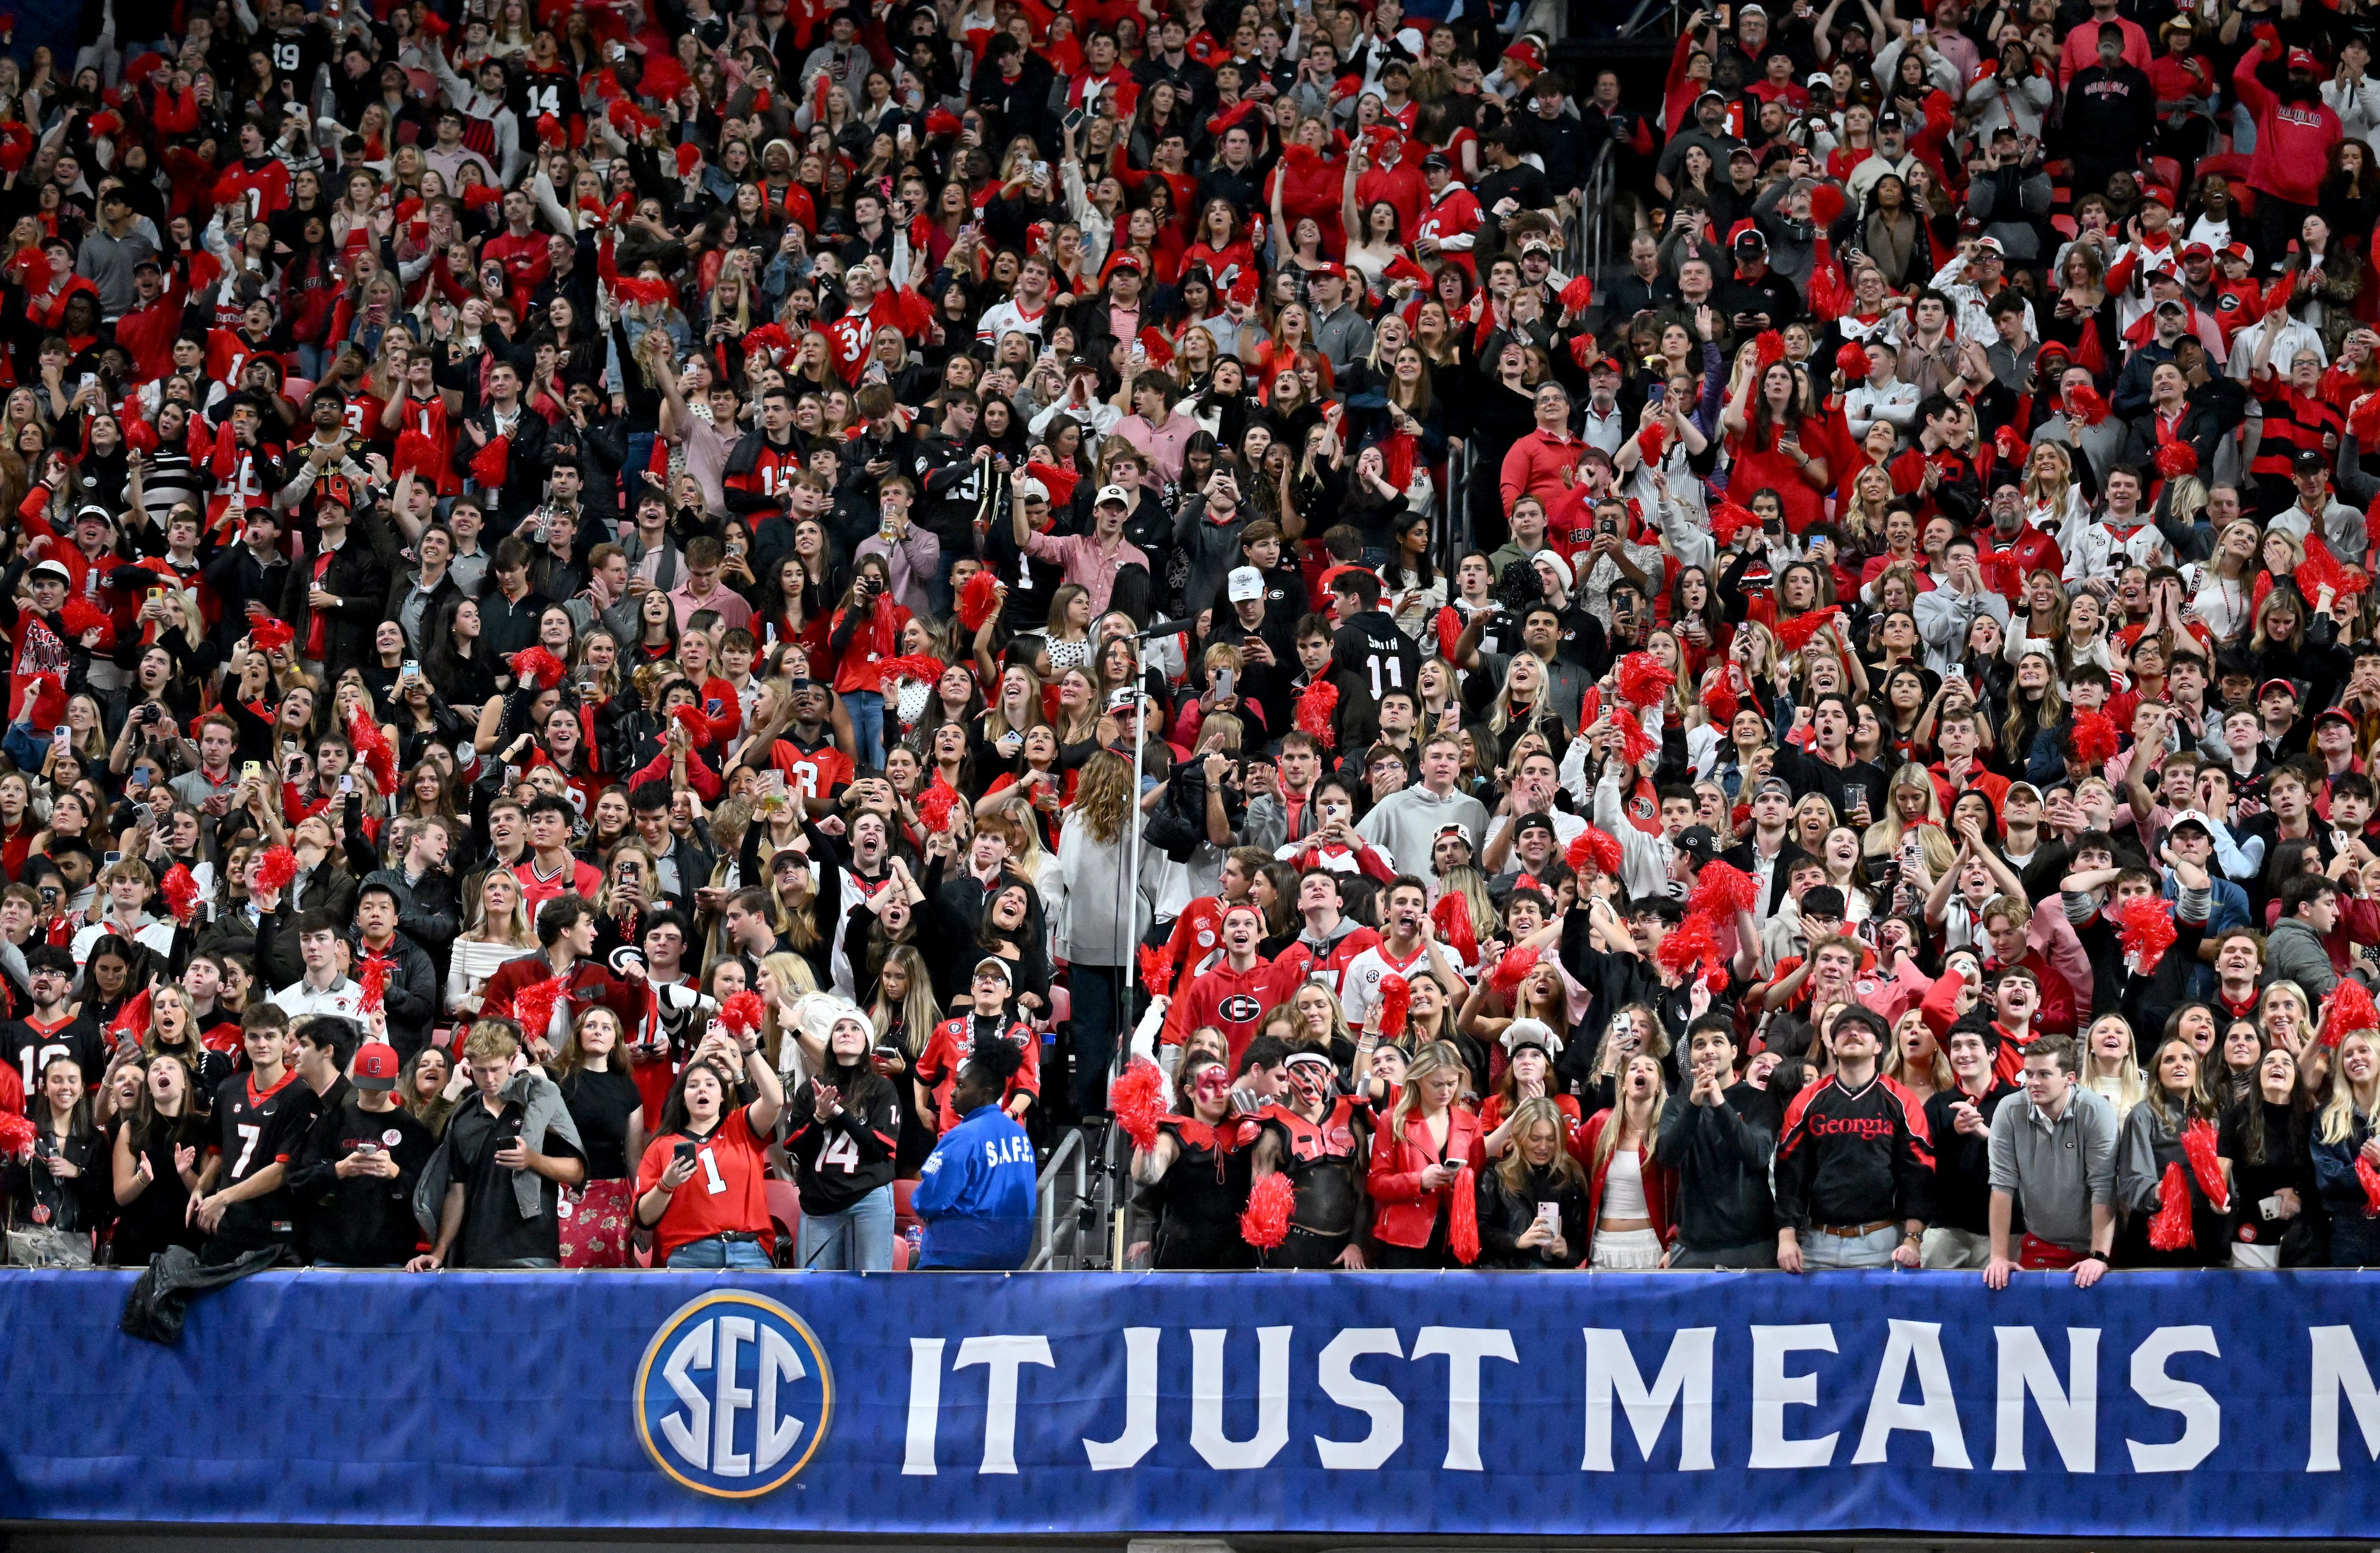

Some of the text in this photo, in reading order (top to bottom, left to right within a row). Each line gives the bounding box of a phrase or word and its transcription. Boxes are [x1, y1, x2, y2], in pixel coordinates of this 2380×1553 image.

[273, 43, 300, 71] 19
[526, 85, 560, 118] 14
[2084, 81, 2130, 98] GEORGIA
[2220, 294, 2241, 310] G
[226, 353, 245, 386] 1
[418, 408, 431, 439] 1
[1018, 551, 1034, 590] 1
[1369, 637, 1399, 651] SMITH
[1366, 655, 1403, 702] 11
[2187, 811, 2196, 819] G
[1367, 969, 1380, 983] SEC
[1224, 996, 1261, 1022] G
[368, 1057, 382, 1074] G
[1809, 1112, 1895, 1140] Georgia
[231, 1123, 262, 1178] 7
[815, 1128, 860, 1174] 14
[698, 1147, 728, 1195] 1
[660, 1316, 805, 1477] SEC
[901, 1335, 1056, 1475] IT
[1083, 1326, 1519, 1471] JUST
[1581, 1319, 2220, 1473] MEANS
